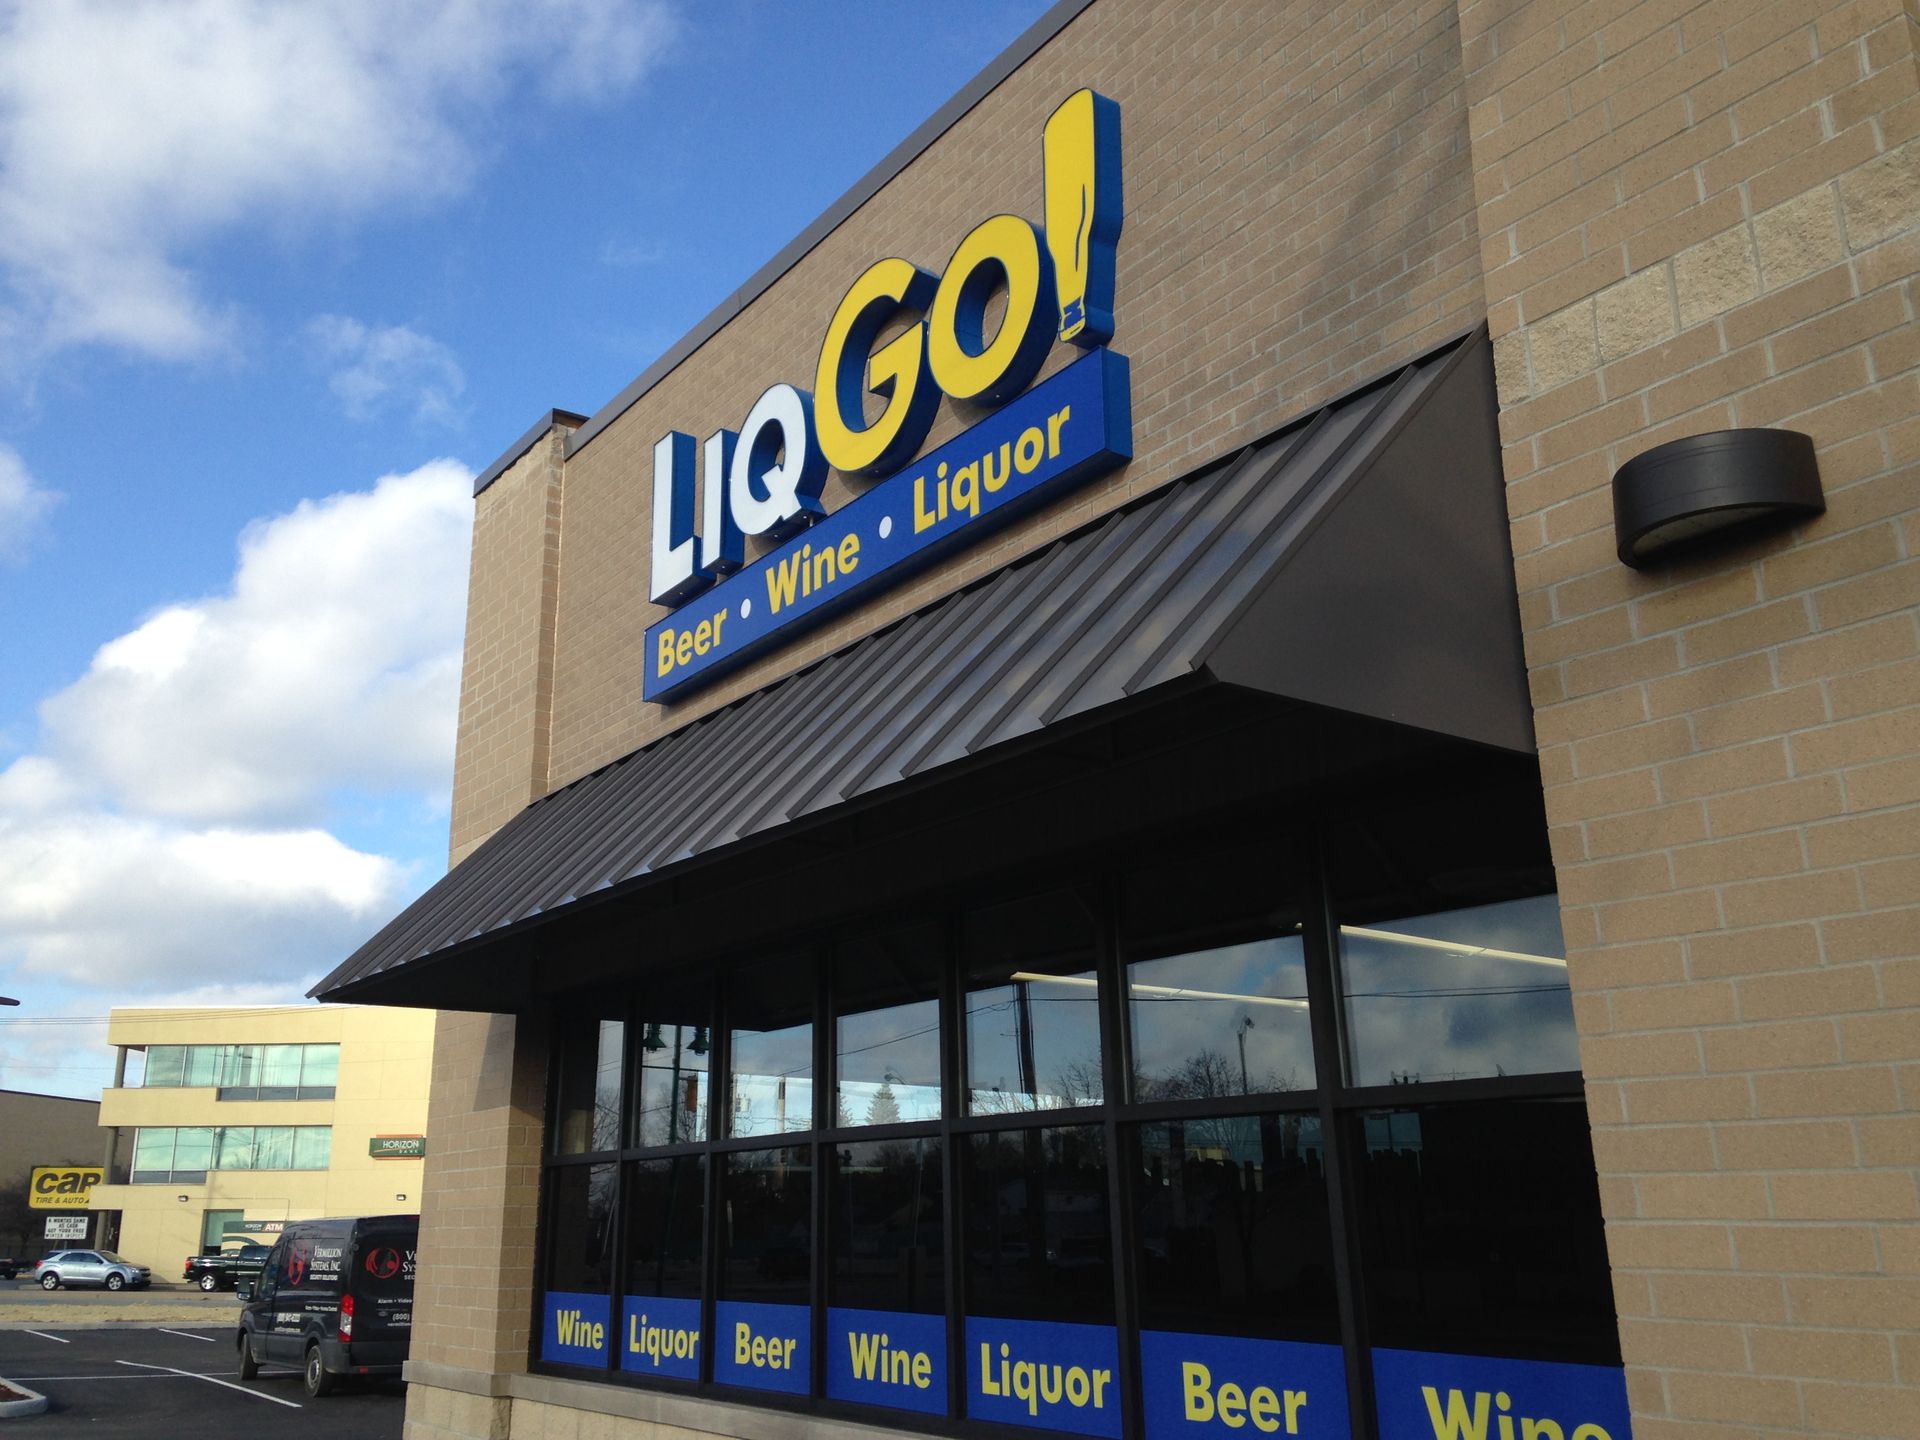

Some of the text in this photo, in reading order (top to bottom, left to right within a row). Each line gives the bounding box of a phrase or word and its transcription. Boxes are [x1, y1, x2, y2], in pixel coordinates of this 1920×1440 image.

[657, 406, 1071, 677] Beer Wine Liquor
[383, 1140, 419, 1148] HORIZON
[265, 1223, 284, 1231] ATM
[556, 1310, 604, 1350] Wine
[629, 1315, 699, 1366] Liquor
[735, 1323, 796, 1370] Beer
[848, 1332, 931, 1389] Wine
[980, 1343, 1111, 1416] Liquor
[1182, 1361, 1307, 1435] Beer
